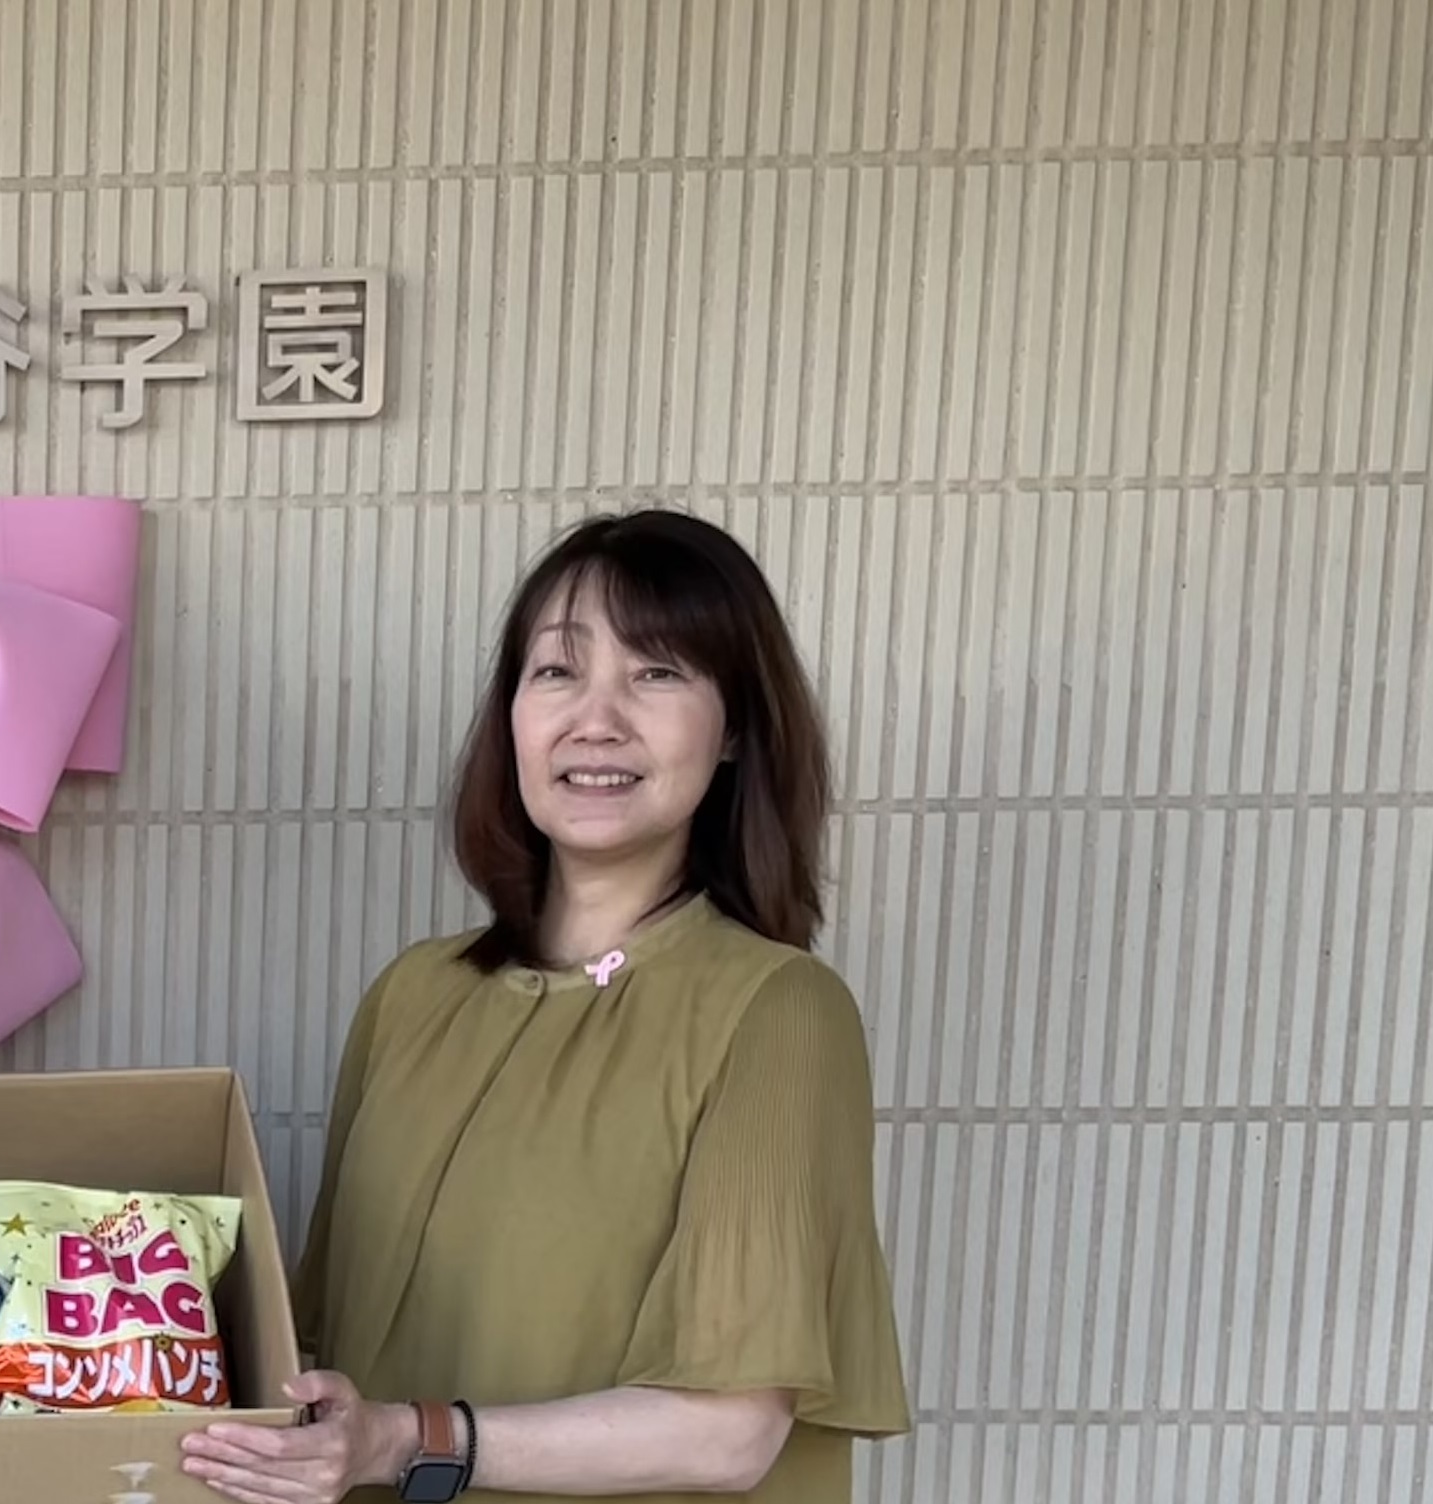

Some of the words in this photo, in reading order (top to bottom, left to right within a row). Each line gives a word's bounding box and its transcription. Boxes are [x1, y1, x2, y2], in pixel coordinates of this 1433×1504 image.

[59, 1230, 190, 1285] BIG
[45, 1280, 206, 1337] BAG
[27, 1338, 223, 1401] コンソメパンチ
